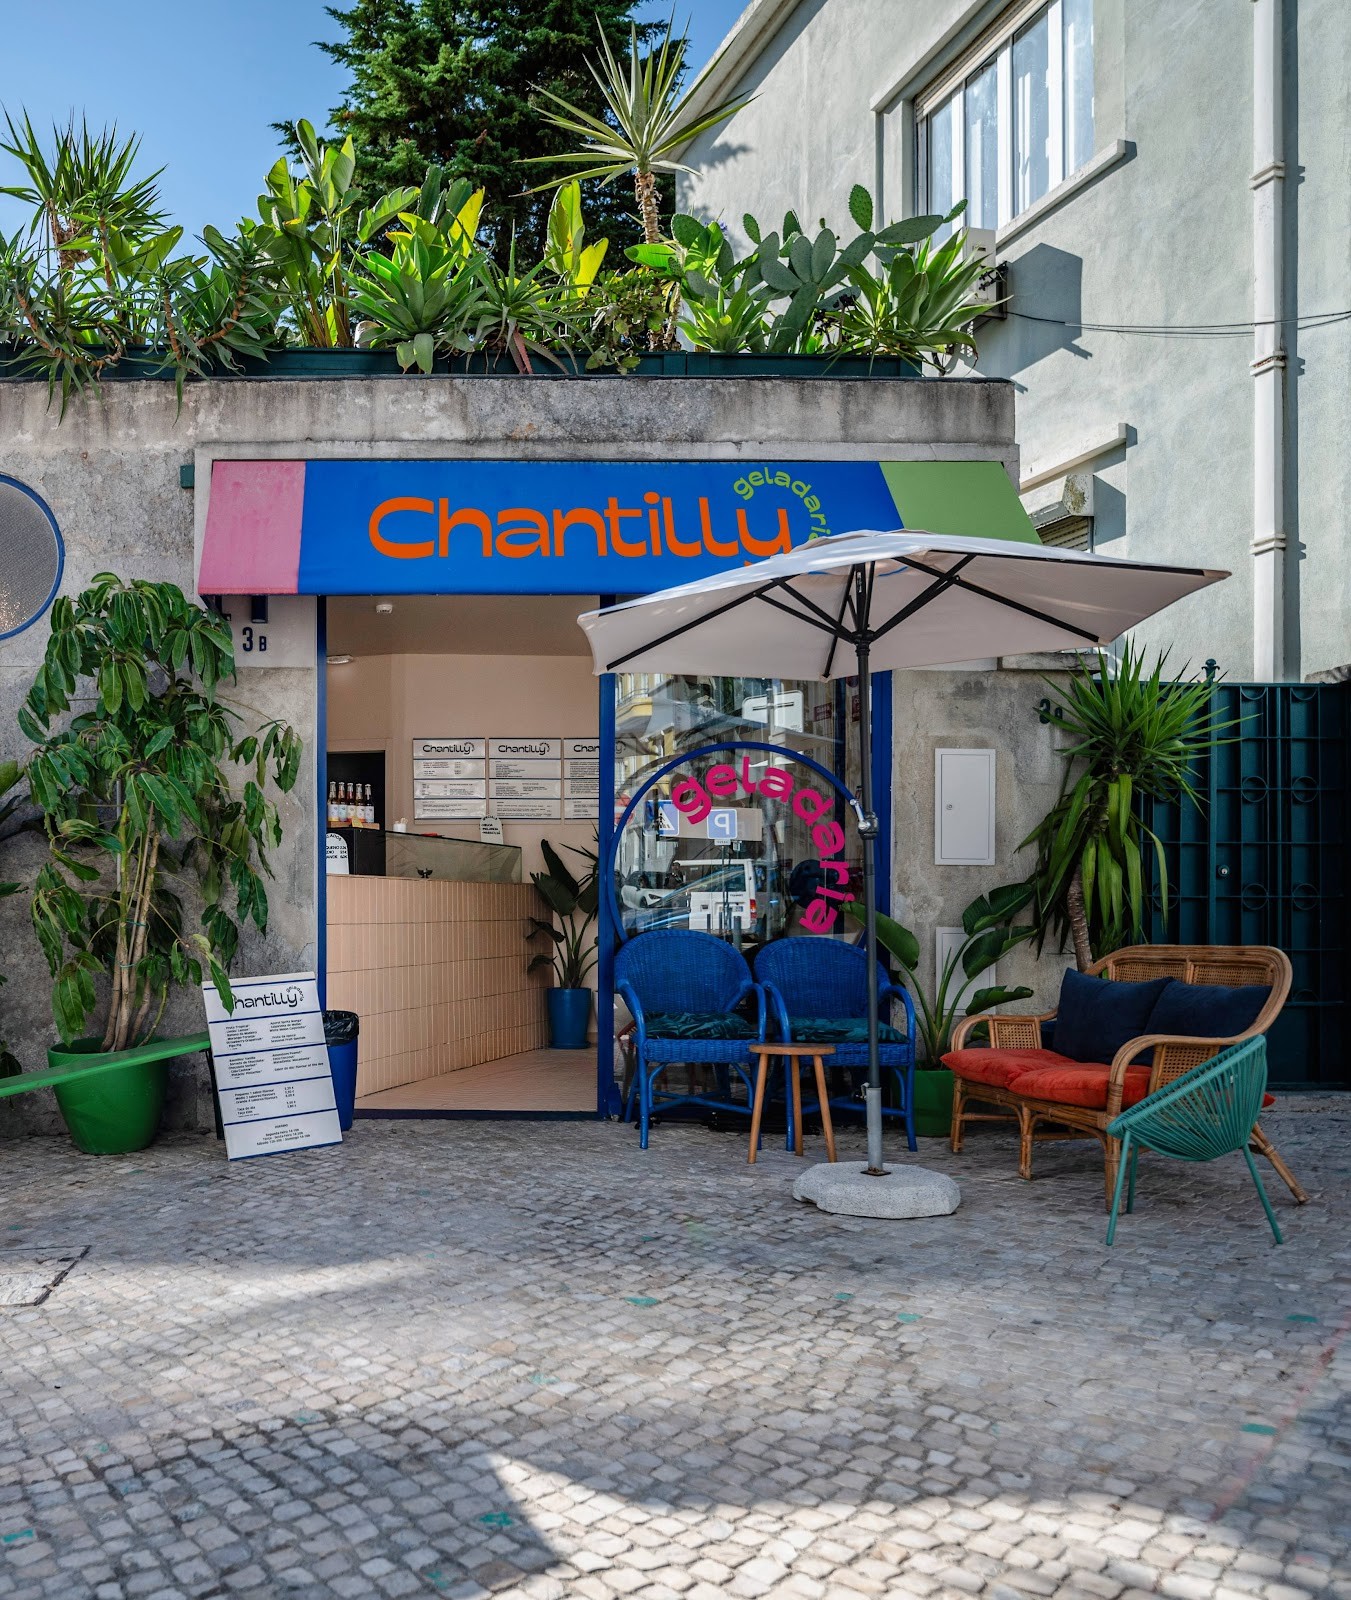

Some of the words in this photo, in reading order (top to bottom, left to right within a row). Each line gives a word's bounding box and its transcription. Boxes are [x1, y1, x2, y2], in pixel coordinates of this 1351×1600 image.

[369, 491, 792, 567] Chantilly
[422, 744, 471, 755] Chantilly
[498, 744, 546, 755] Chantilly
[671, 756, 856, 934] geladaria
[234, 992, 298, 1009] hantilly
